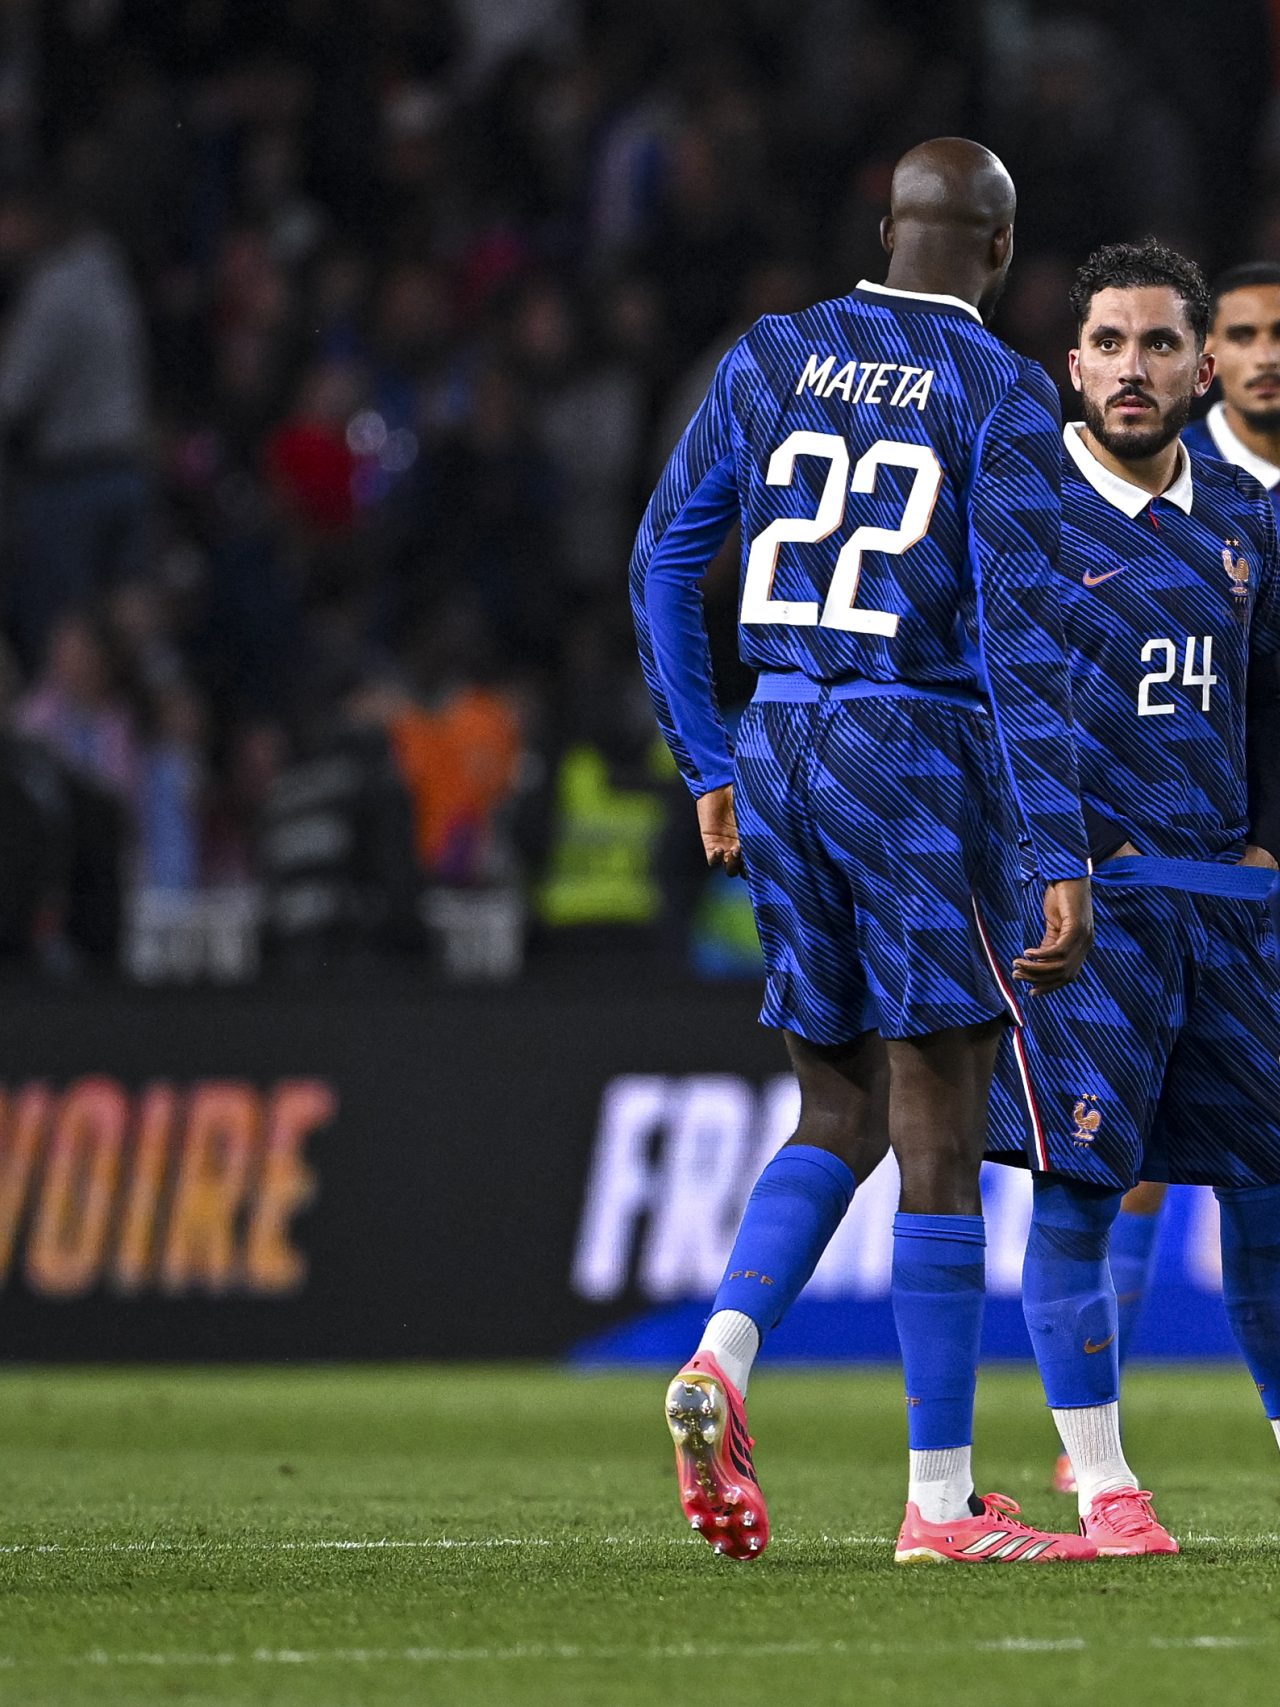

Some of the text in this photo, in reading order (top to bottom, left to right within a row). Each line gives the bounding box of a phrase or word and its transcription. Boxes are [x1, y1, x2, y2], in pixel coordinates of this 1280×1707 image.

[795, 353, 935, 411] MATETA
[740, 430, 945, 638] 22
[1138, 636, 1217, 716] 24
